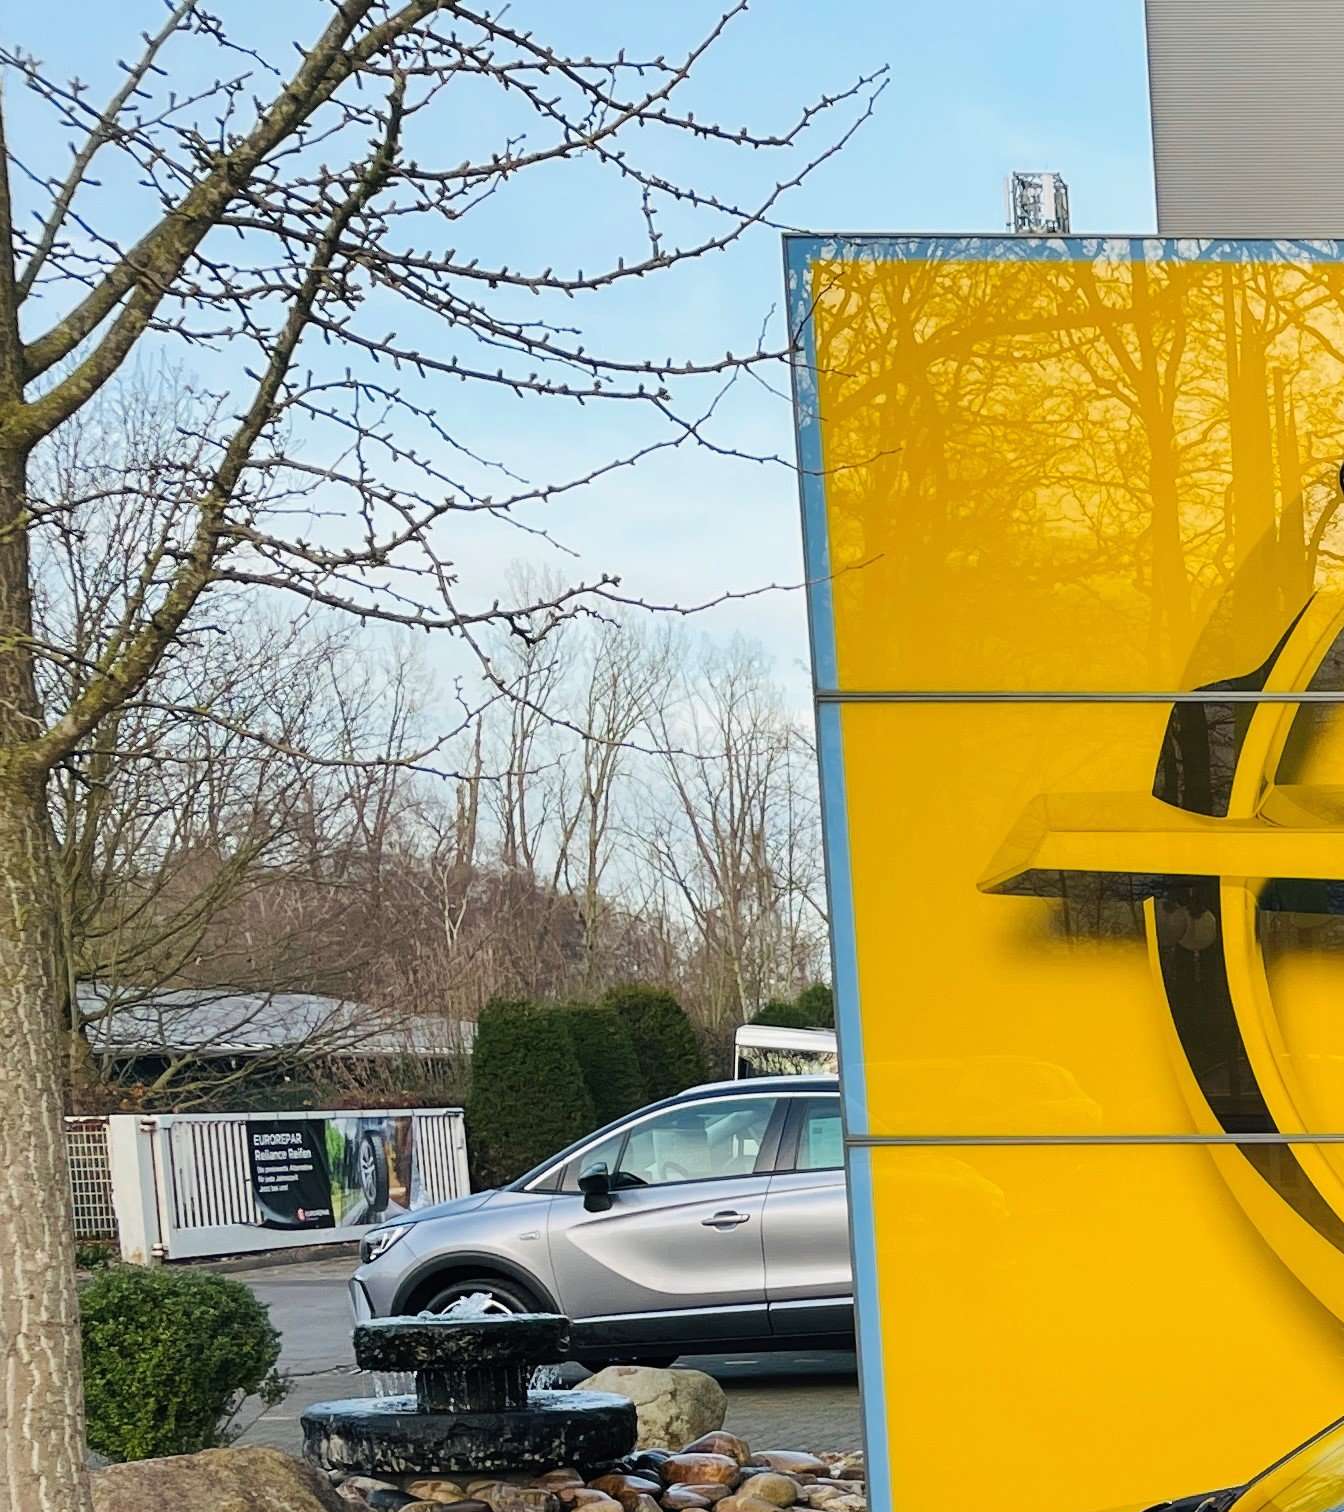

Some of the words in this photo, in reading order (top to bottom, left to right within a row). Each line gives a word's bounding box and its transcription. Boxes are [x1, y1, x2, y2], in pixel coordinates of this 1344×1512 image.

[253, 1132, 303, 1146] EUROREPAR
[254, 1149, 287, 1161] Reliance
[288, 1147, 312, 1159] Reifen
